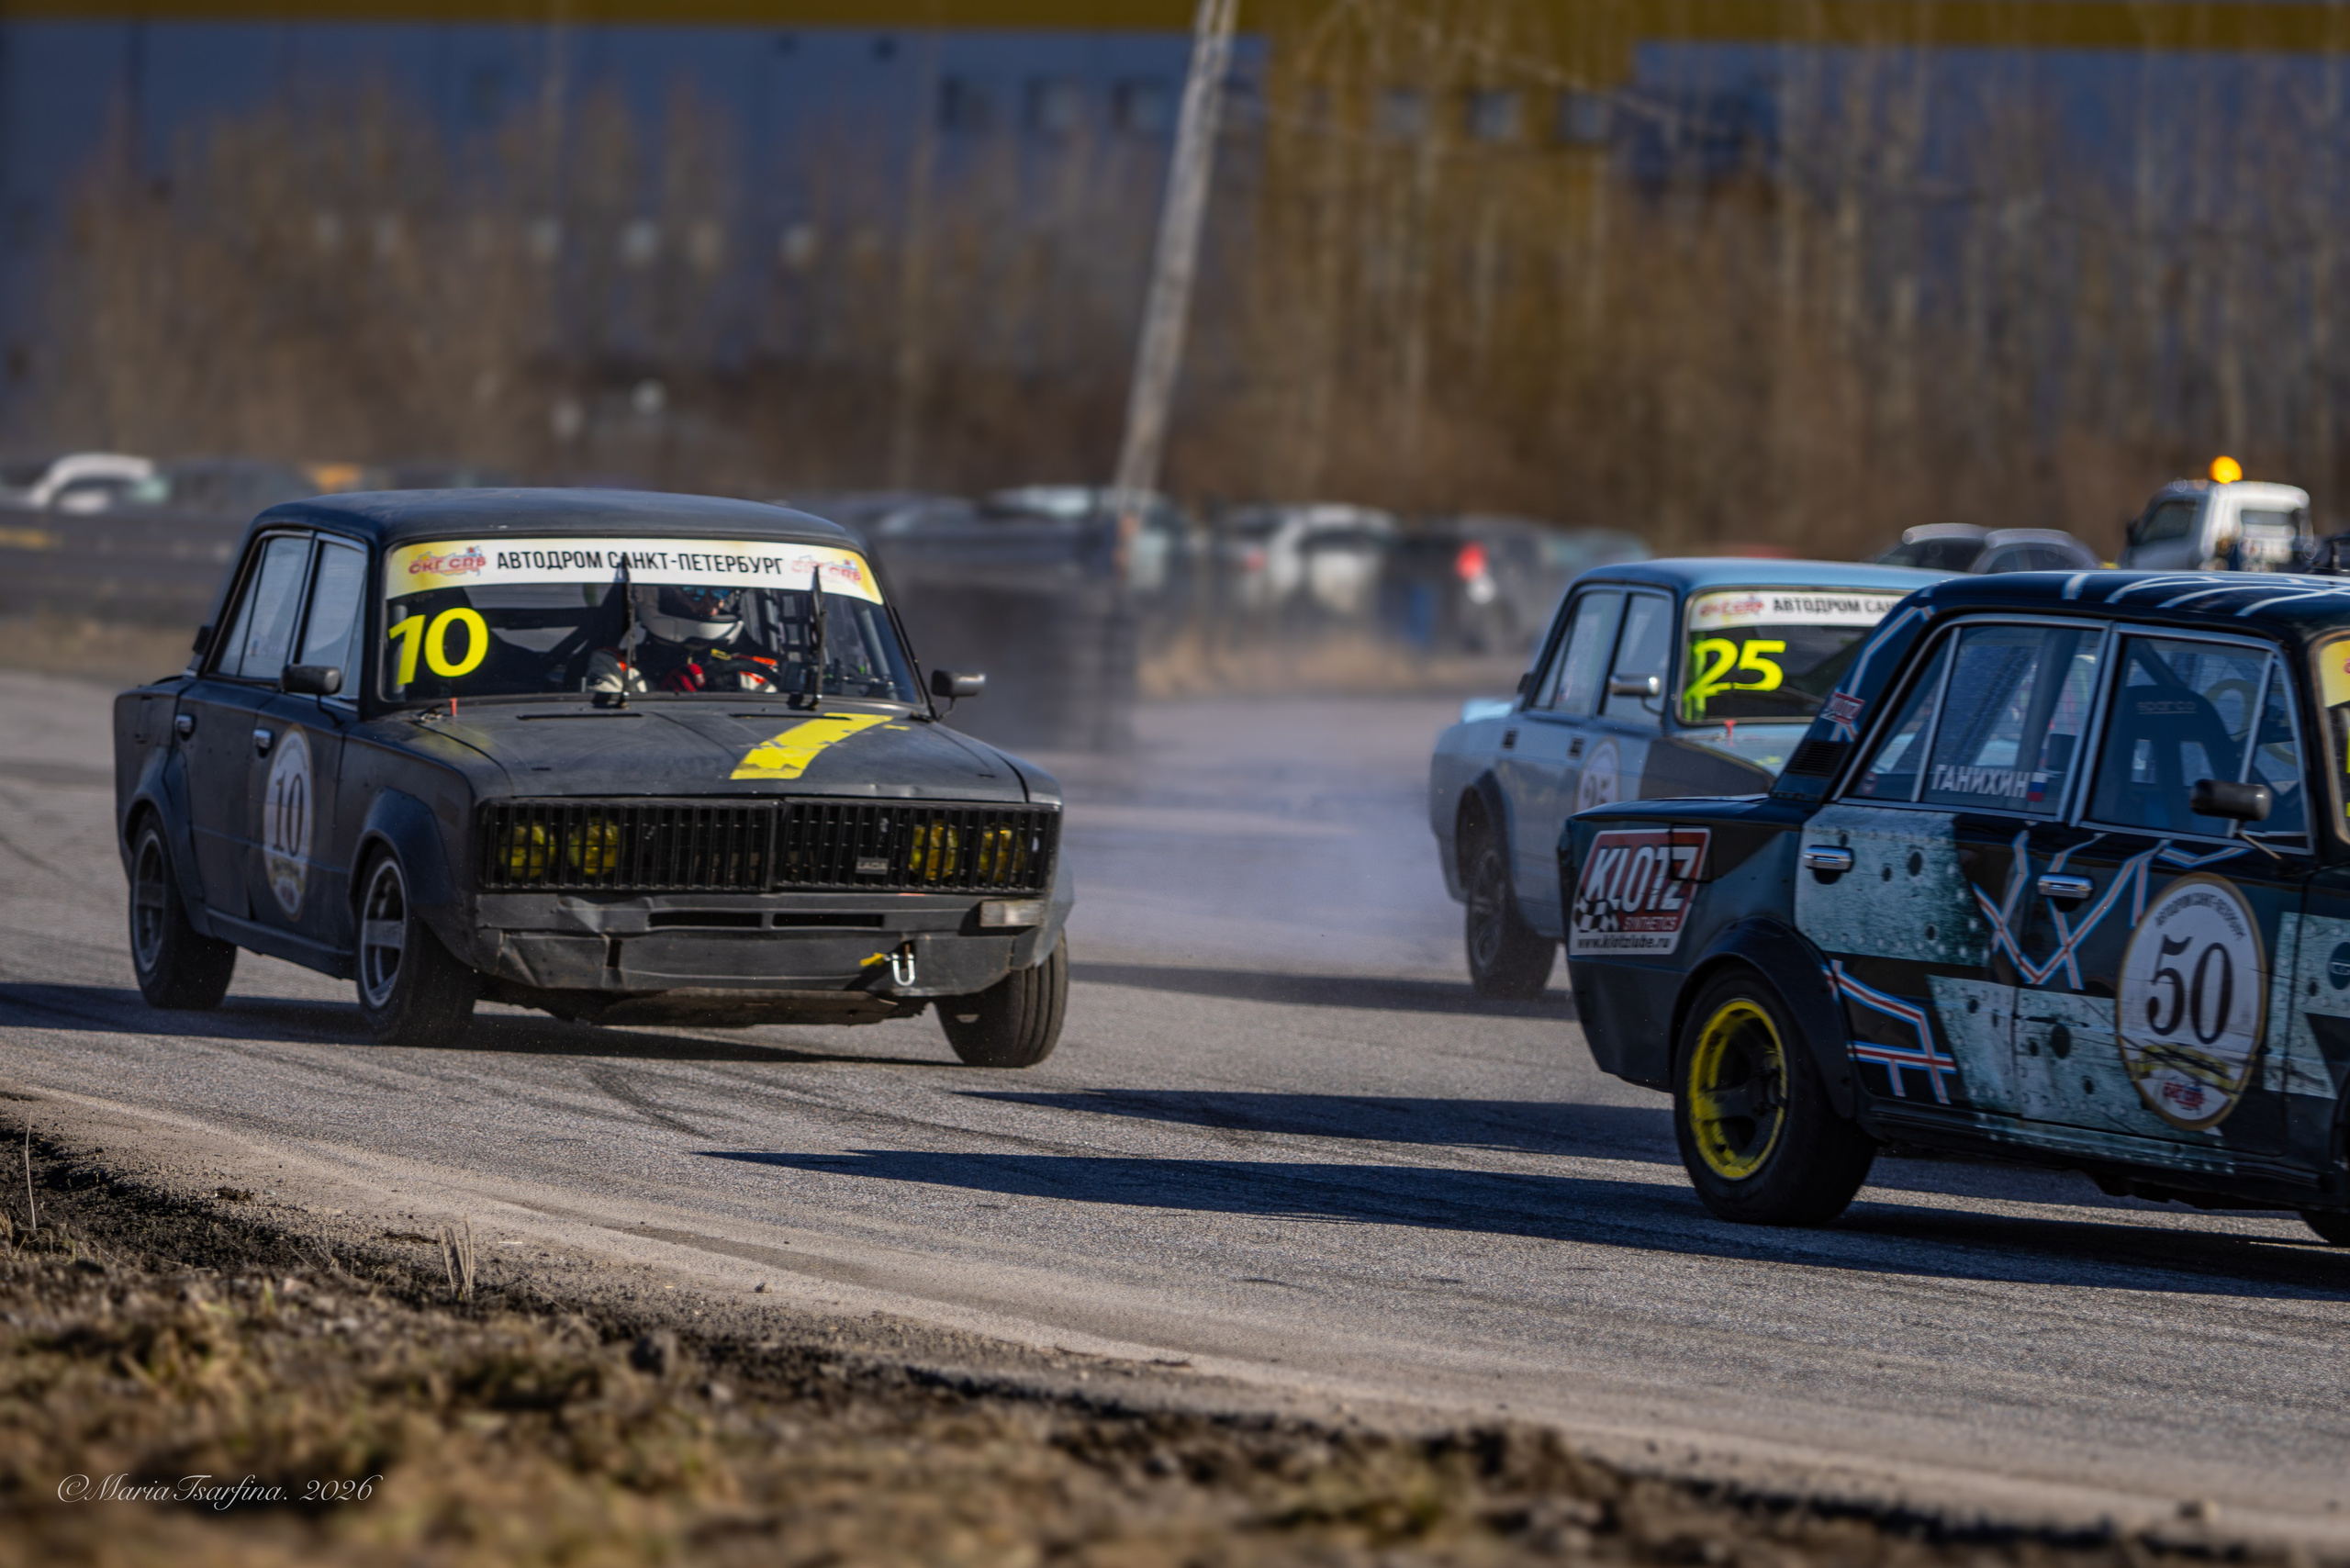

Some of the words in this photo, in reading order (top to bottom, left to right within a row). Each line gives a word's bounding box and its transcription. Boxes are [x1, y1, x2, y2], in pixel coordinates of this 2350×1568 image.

[498, 551, 603, 570] АВТОДРОМ
[608, 551, 785, 576] САНКТ-ПЕТЕРБУРГ
[1773, 597, 1861, 614] АВТОДРОМ
[388, 607, 489, 686] 10
[1686, 637, 1786, 698] 25
[273, 770, 304, 857] 10
[1931, 764, 2031, 799] ГАНИХИН
[1584, 845, 1700, 913] KLOTZ
[2146, 934, 2233, 1045] 50
